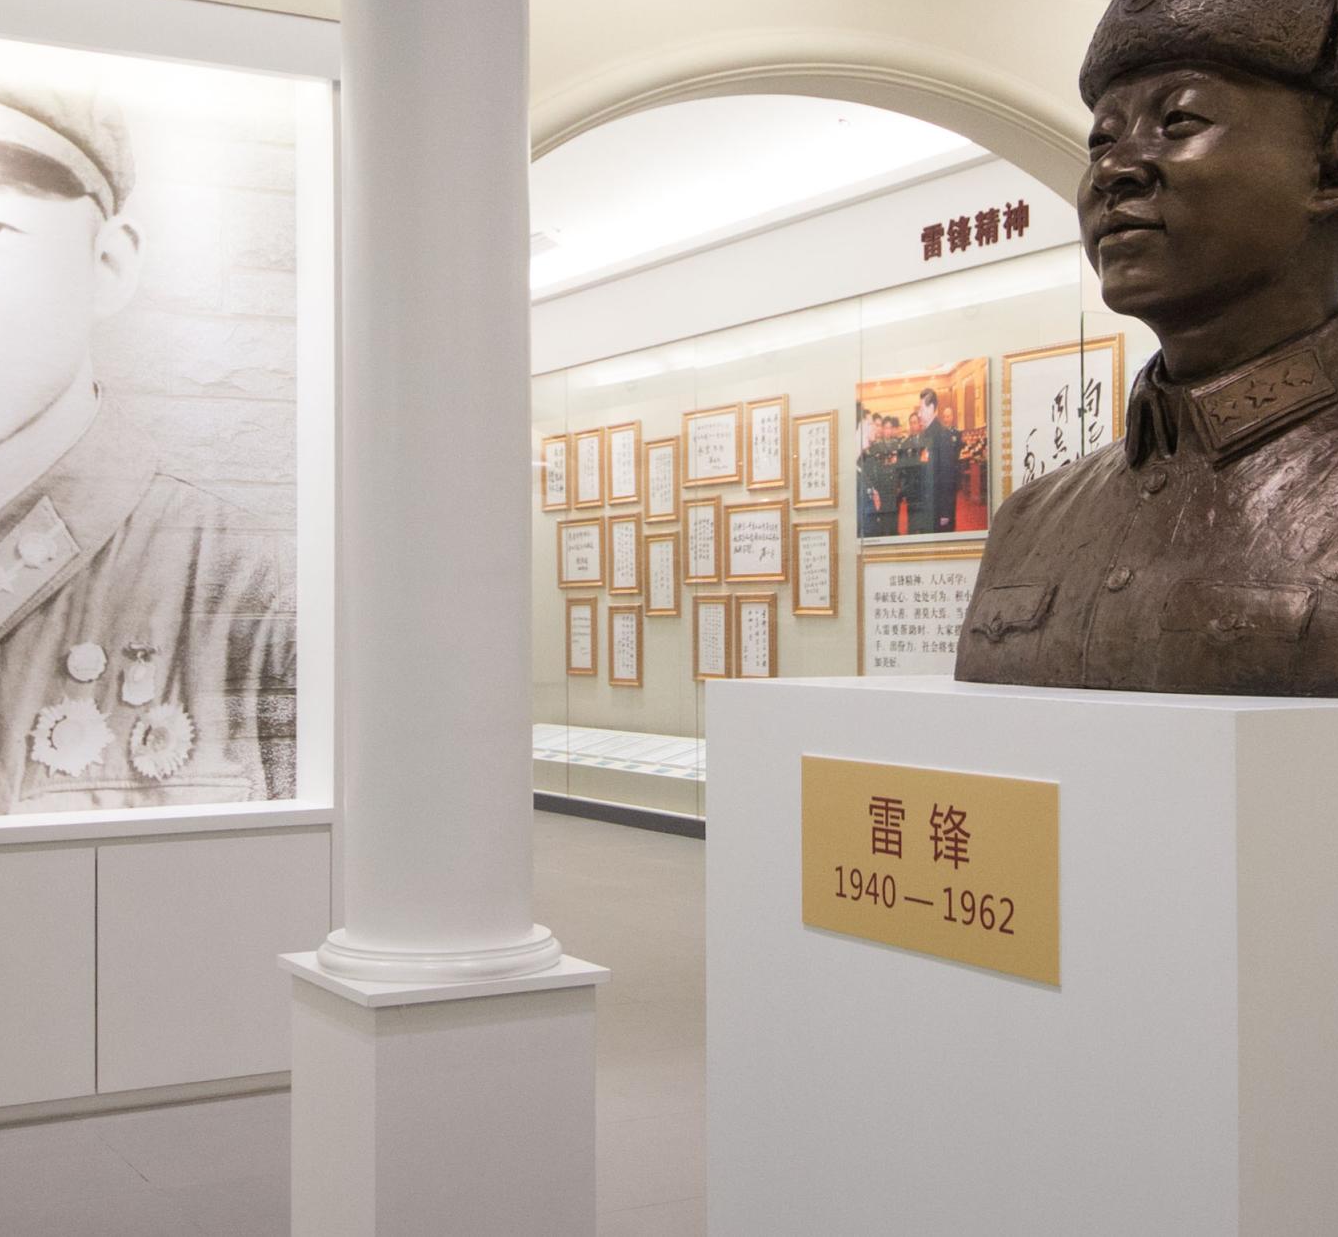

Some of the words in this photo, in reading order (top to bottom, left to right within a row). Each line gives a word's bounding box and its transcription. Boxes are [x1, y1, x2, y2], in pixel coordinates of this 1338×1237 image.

[920, 199, 1030, 262] 雷锋精神
[869, 796, 971, 870] 雷锋
